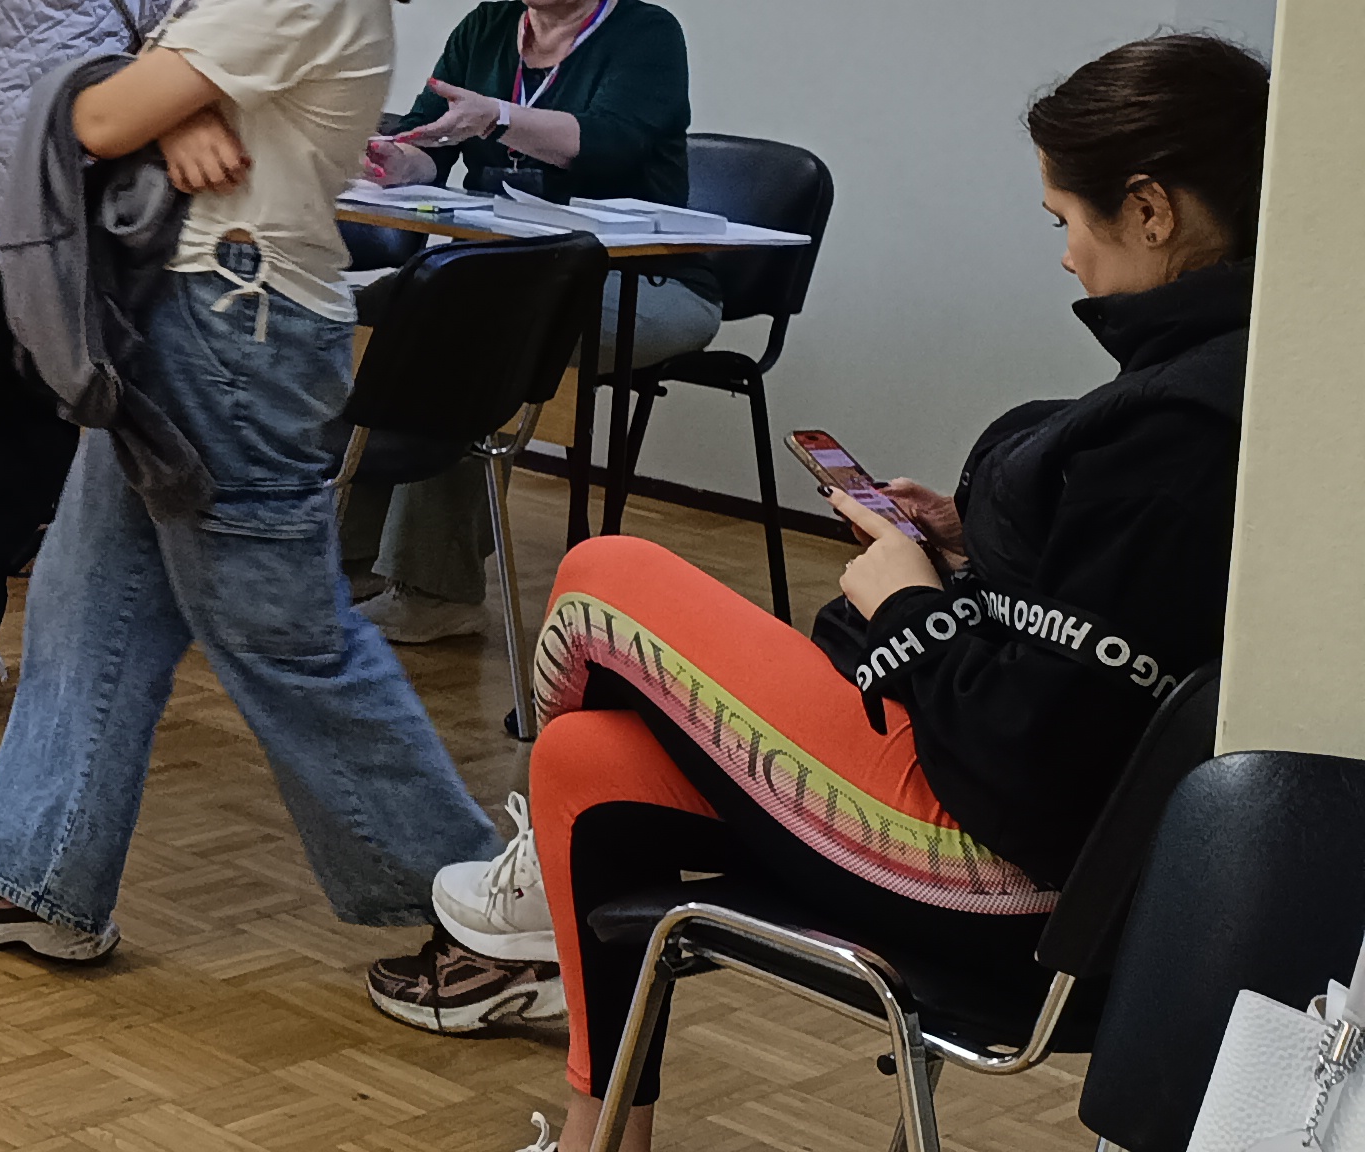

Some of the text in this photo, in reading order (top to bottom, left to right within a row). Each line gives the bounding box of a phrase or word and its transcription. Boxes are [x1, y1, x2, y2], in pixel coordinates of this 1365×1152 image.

[856, 597, 982, 692] GO HUG
[1013, 600, 1093, 650] HUGO
[1095, 636, 1177, 698] UGO
